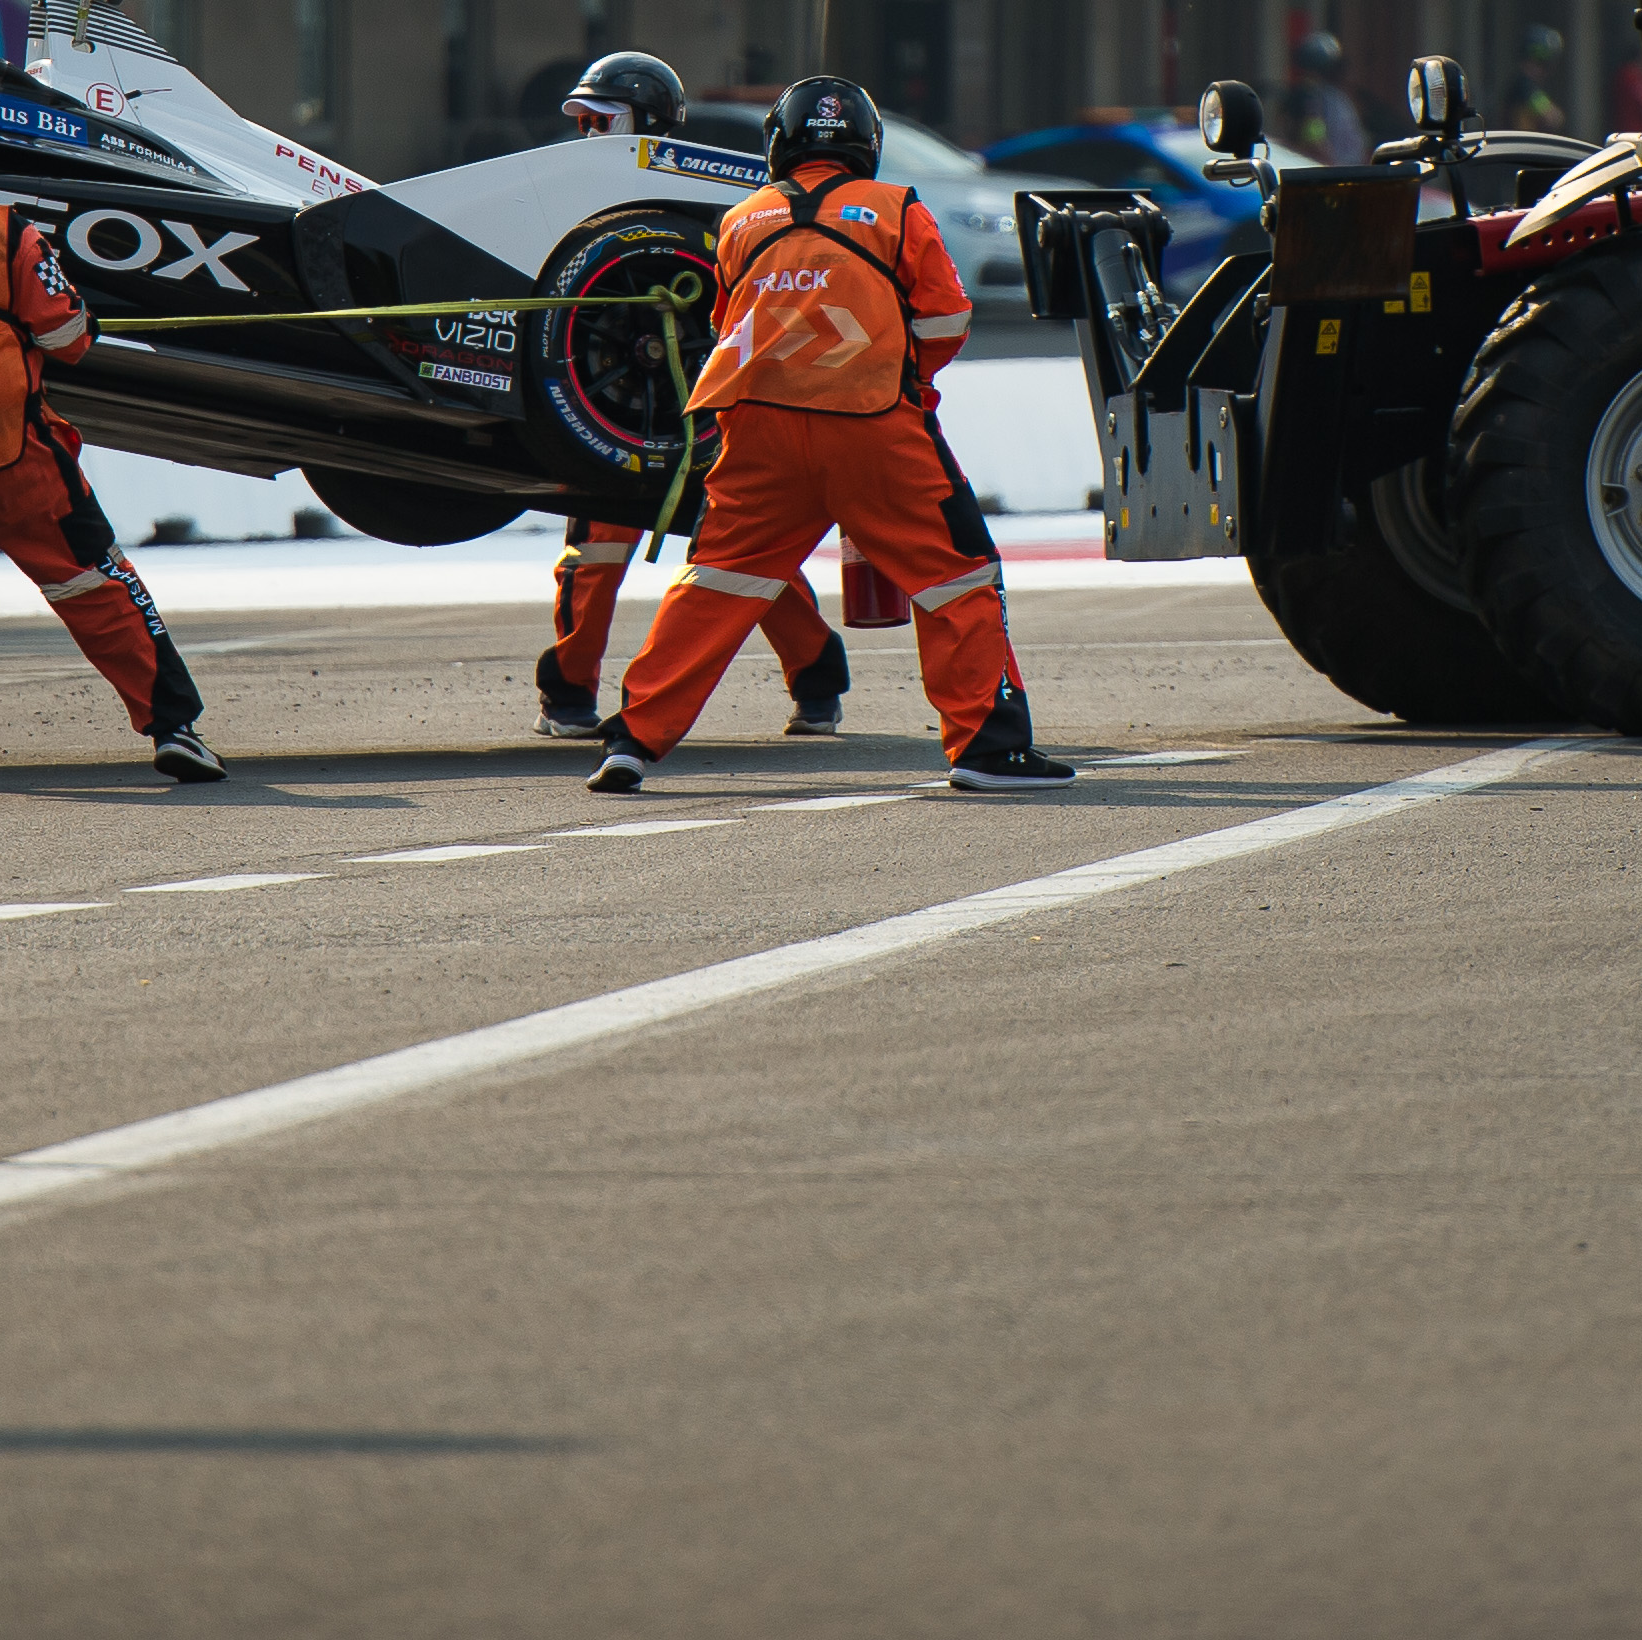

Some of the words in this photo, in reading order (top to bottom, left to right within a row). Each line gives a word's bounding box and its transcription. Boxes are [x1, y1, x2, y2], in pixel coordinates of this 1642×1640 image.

[96, 89, 114, 112] E
[37, 110, 82, 138] Bär
[806, 118, 847, 128] RODA
[101, 133, 126, 148] ABB
[275, 143, 362, 193] PENS
[753, 269, 832, 297] TRACK
[436, 318, 515, 352] VIZIO
[549, 384, 614, 456] MICHELIN
[100, 555, 167, 636] MARSHAL
